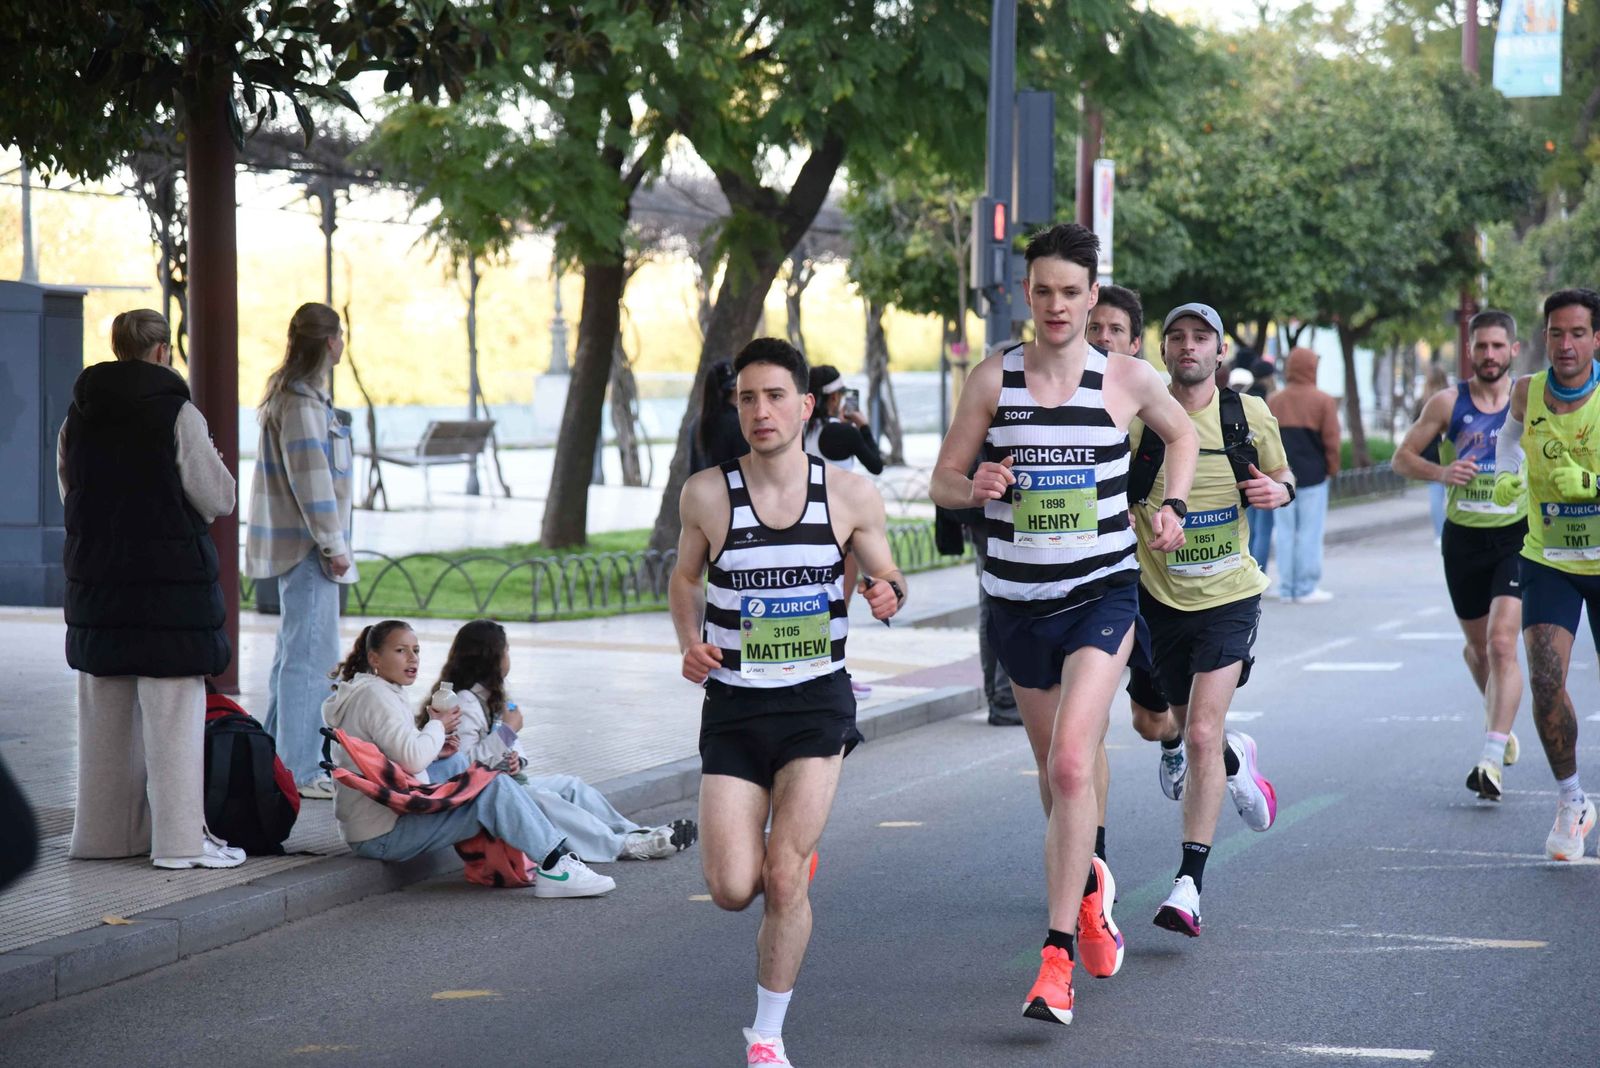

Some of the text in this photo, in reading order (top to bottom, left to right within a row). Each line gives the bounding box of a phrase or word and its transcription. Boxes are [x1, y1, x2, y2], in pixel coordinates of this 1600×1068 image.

[1004, 409, 1034, 421] soar
[1010, 448, 1096, 463] HIGHGATE
[1037, 474, 1086, 486] ZURICH
[1040, 498, 1066, 509] 1898
[1028, 513, 1080, 530] HENRY
[1191, 510, 1232, 525] ZURICH
[1194, 533, 1216, 544] 1851
[1563, 535, 1591, 547] TMT
[1175, 541, 1233, 563] NICOLAS
[731, 567, 833, 589] HIGHGATE
[771, 599, 821, 614] ZURICH
[773, 626, 800, 638] 3105
[746, 638, 827, 660] MATTHEW
